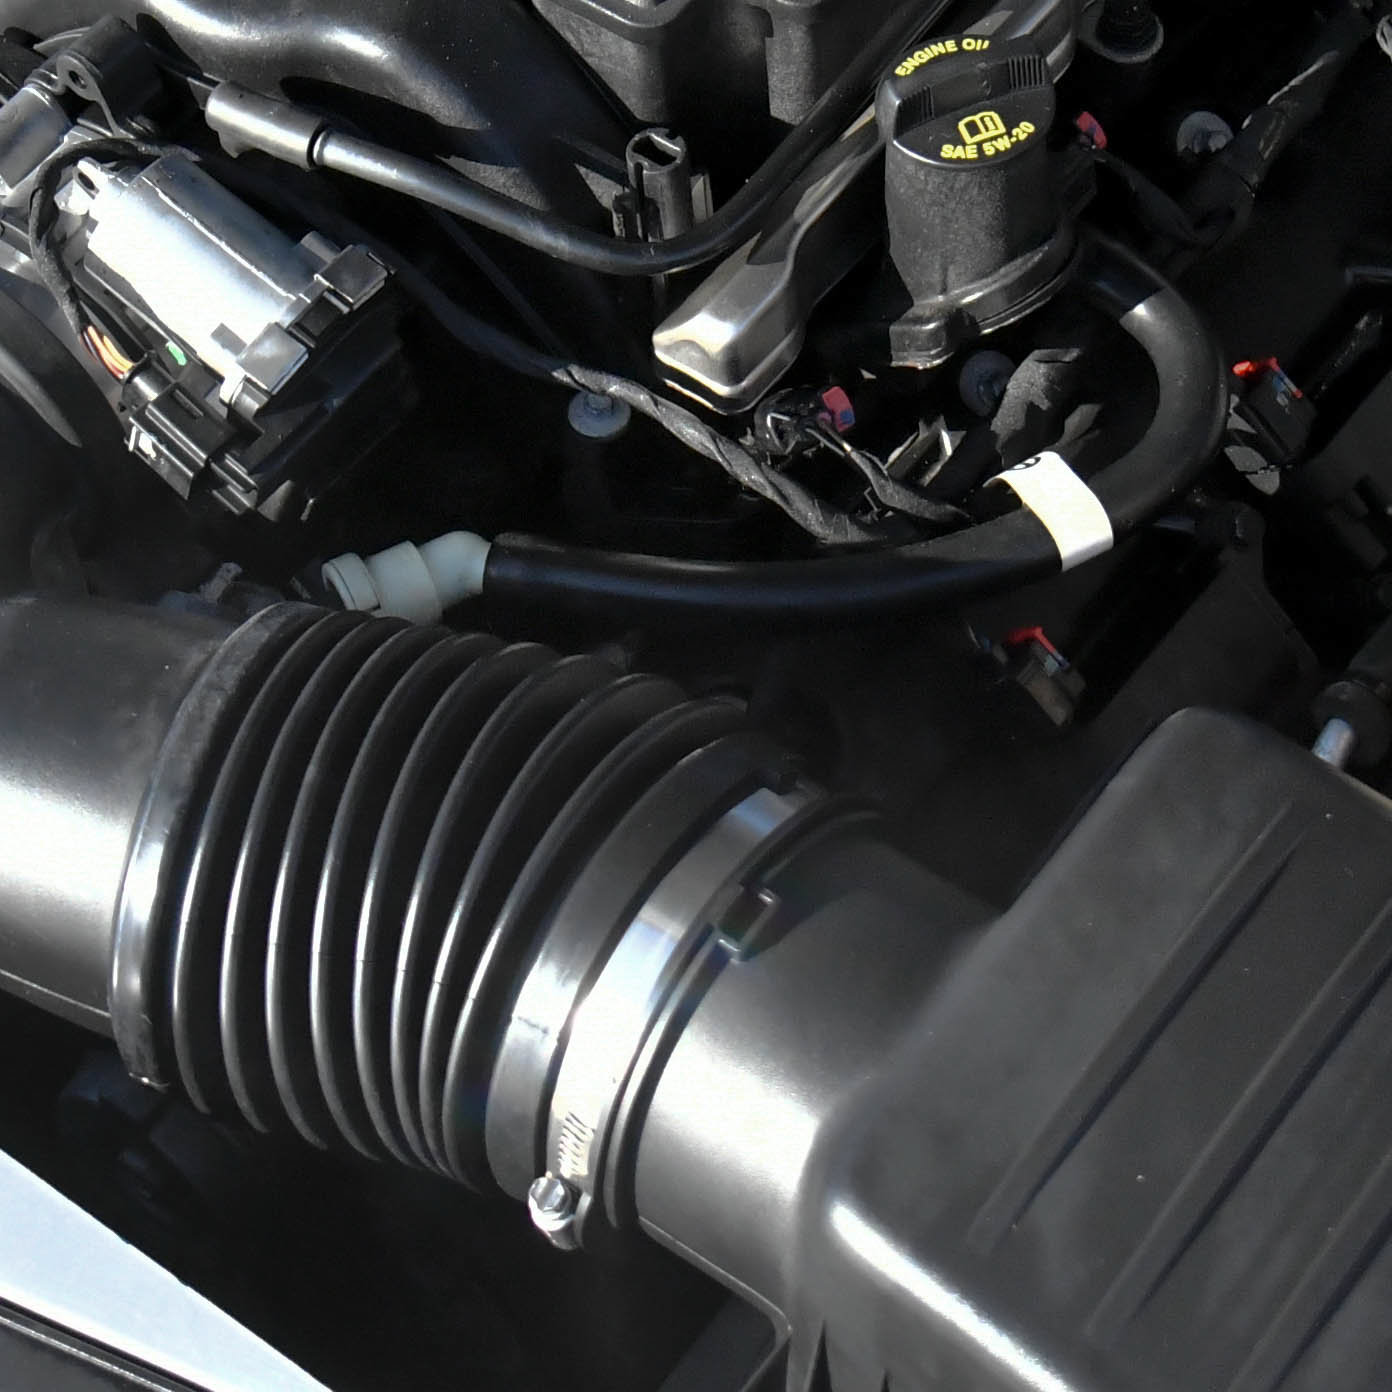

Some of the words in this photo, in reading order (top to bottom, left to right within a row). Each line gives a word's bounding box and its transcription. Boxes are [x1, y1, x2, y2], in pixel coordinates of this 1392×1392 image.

[894, 39, 958, 77] ENGINE
[940, 143, 979, 159] SAE
[983, 120, 1036, 157] 5W-20
